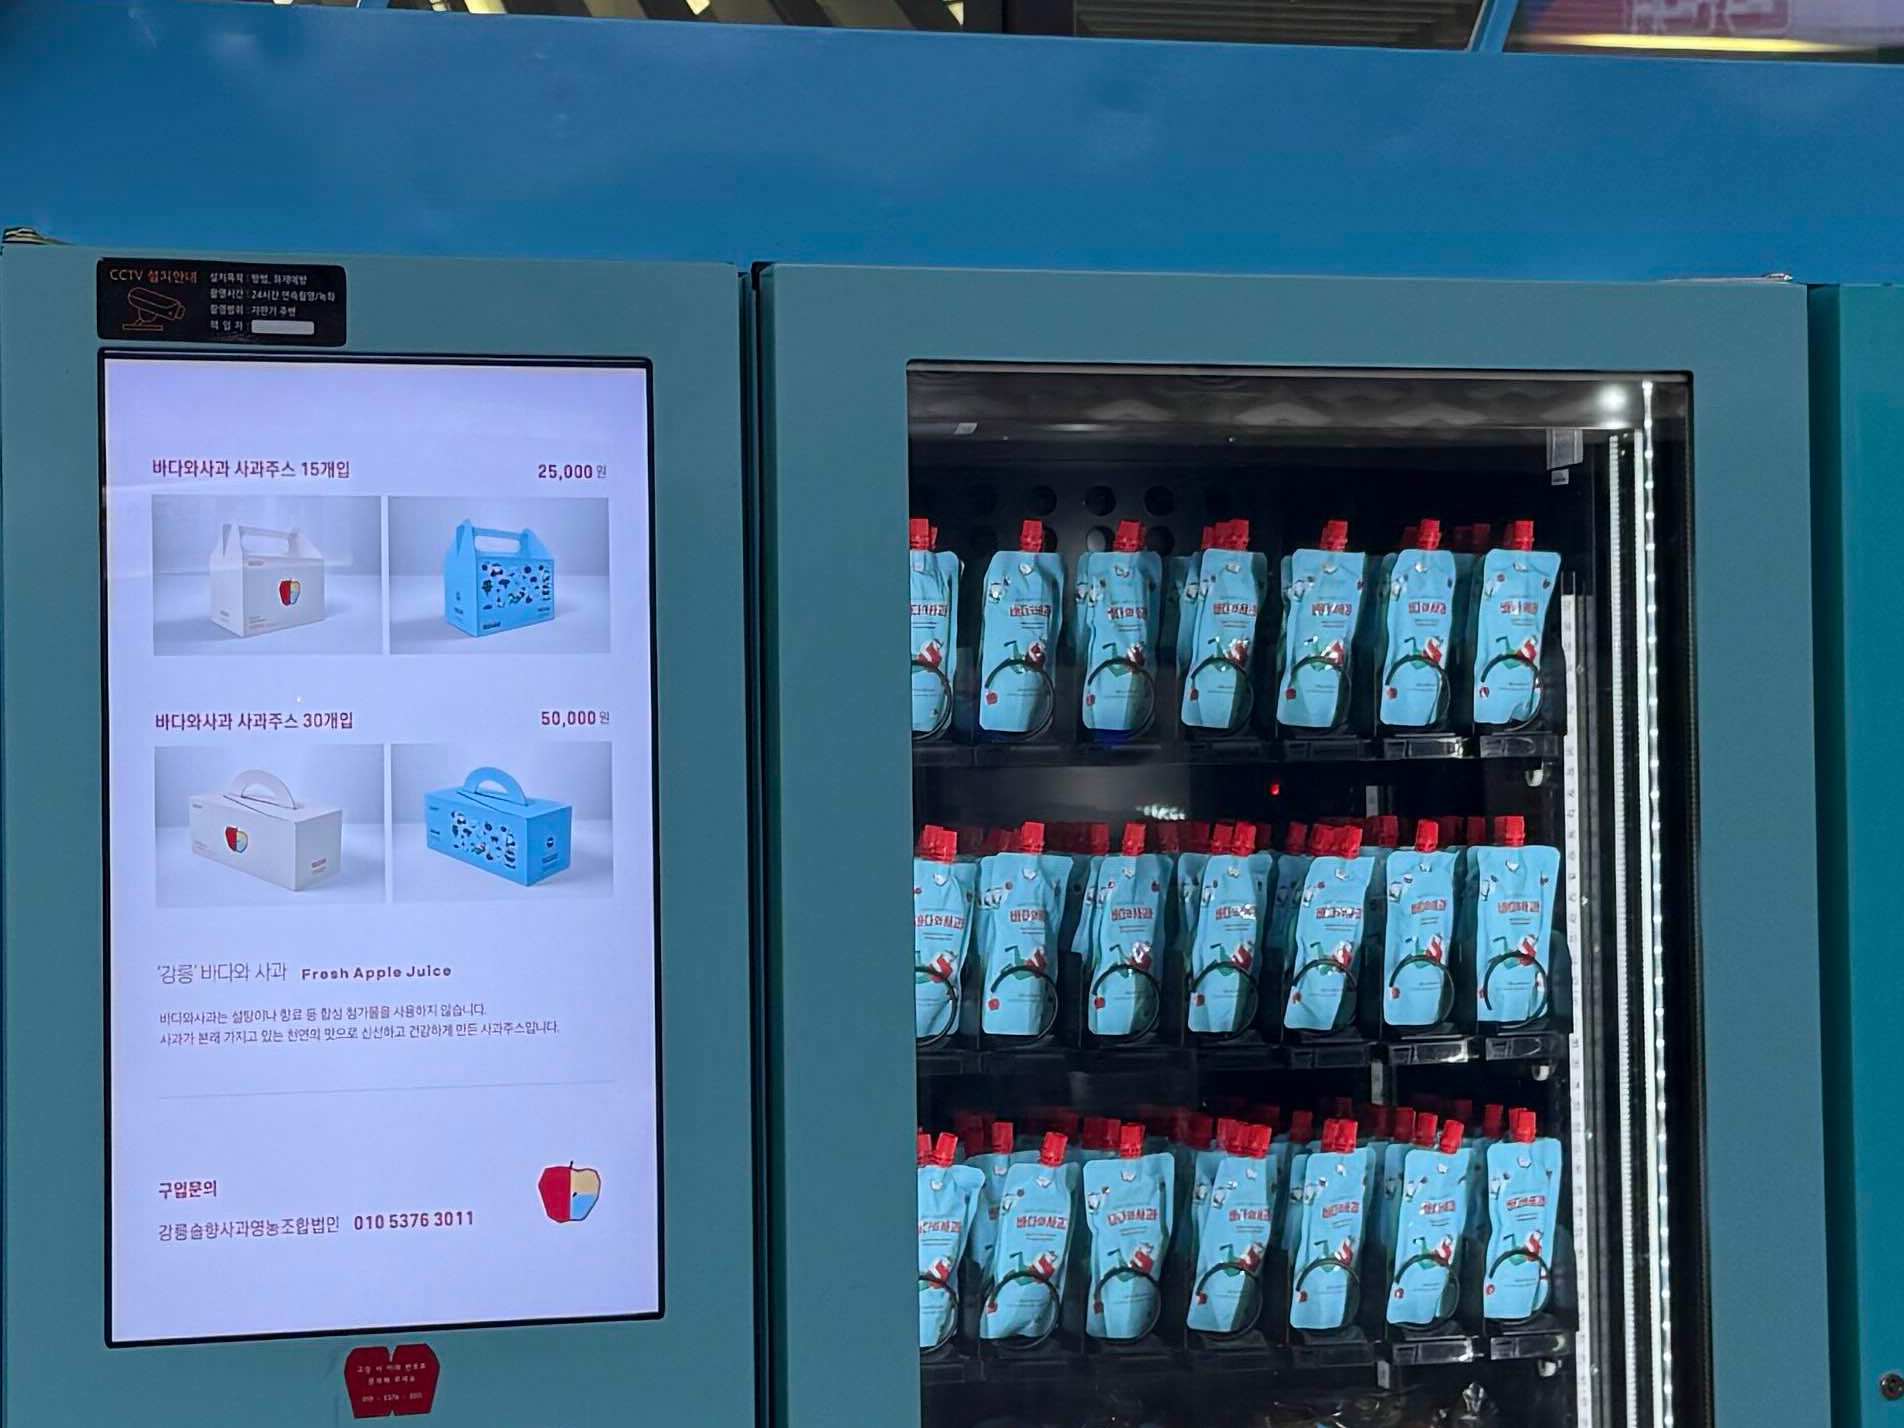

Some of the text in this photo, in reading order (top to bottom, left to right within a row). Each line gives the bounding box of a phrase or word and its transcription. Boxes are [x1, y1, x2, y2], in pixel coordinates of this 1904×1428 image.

[109, 269, 144, 281] CCTV
[151, 458, 351, 479] 바다와사과 사과주스 15개입
[537, 463, 593, 481] 25,000
[154, 711, 353, 731] 바다와사과 사과주스 30개입
[540, 710, 597, 728] 50,000
[200, 962, 249, 983] 바다와
[255, 961, 287, 981] 사과
[301, 964, 452, 981] Fresh Apple Juice
[159, 1011, 228, 1025] 바다와사과는
[159, 1032, 194, 1046] 사과가
[224, 1030, 257, 1044] 가지고
[261, 1029, 284, 1043] 있는
[159, 1179, 218, 1200] 구입문의
[354, 1213, 385, 1231] 010
[388, 1211, 430, 1230] 5376
[434, 1210, 475, 1228] 3011
